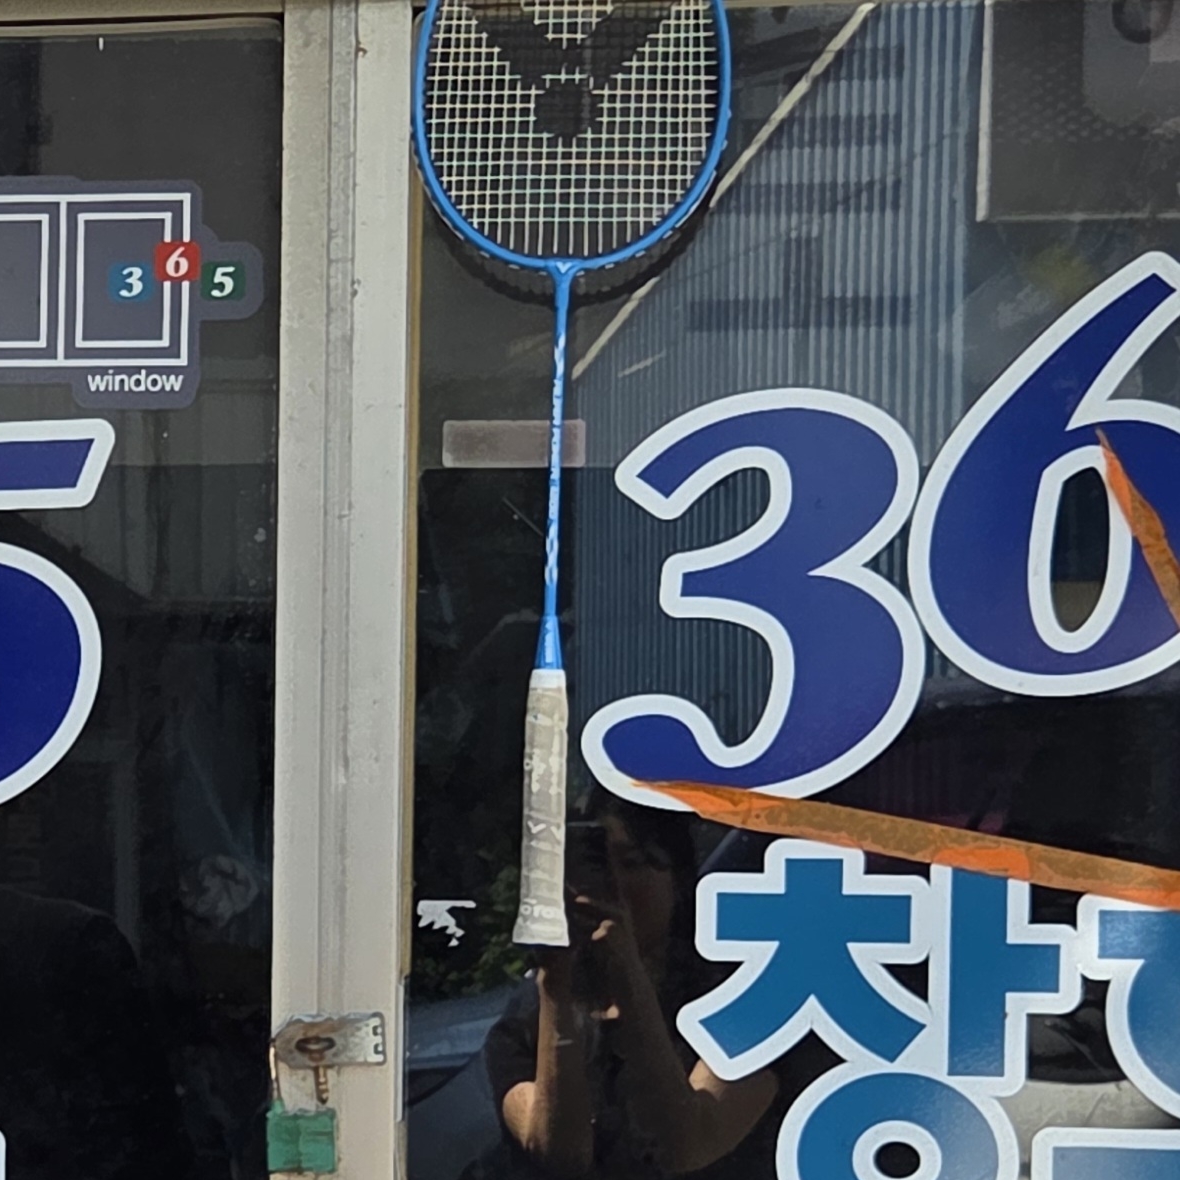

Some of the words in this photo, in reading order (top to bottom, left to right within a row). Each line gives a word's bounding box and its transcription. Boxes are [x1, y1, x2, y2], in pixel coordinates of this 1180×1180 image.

[118, 246, 236, 298] 365
[87, 369, 184, 392] window
[583, 253, 1180, 810] 36
